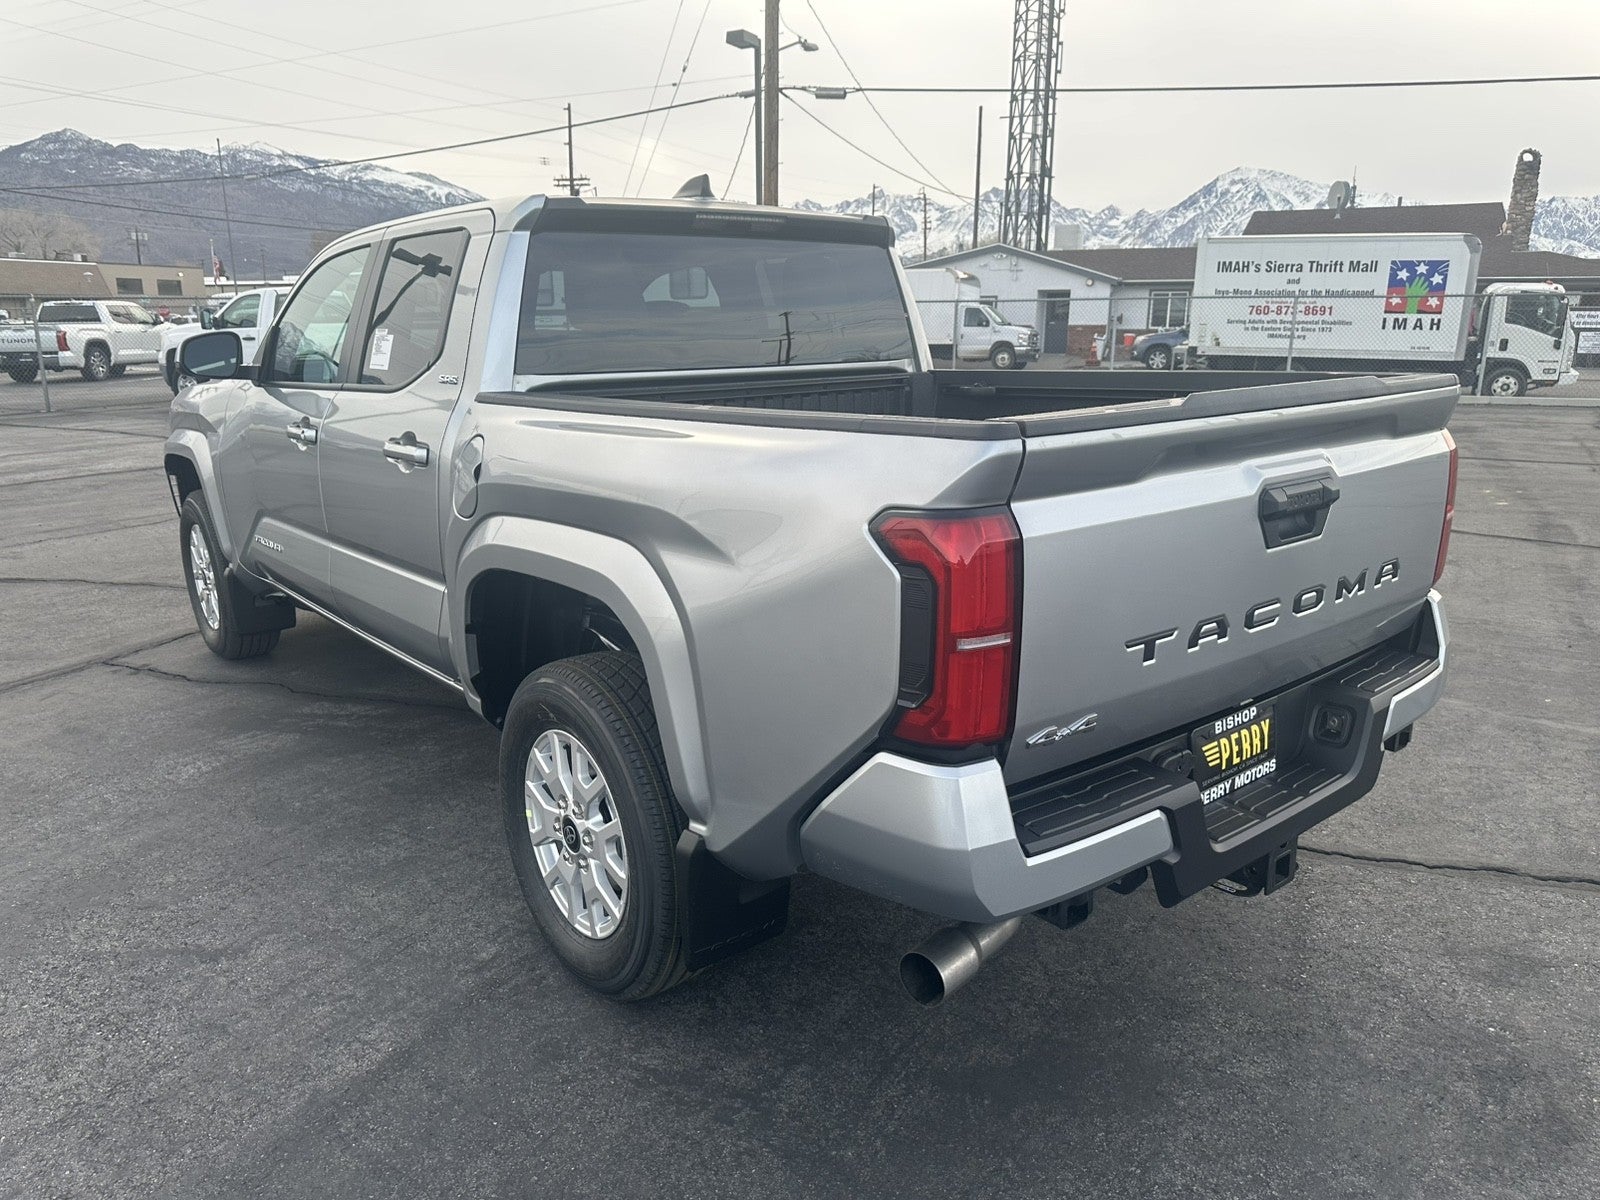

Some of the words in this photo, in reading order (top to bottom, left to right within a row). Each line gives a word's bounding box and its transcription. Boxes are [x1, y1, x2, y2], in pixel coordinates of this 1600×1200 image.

[1216, 260, 1261, 273] IMAH's
[1265, 260, 1303, 273] Sierra
[1308, 260, 1344, 273] Thrift
[1347, 260, 1378, 273] Mall
[1286, 277, 1301, 285] and
[1254, 288, 1296, 297] Association
[1298, 288, 1309, 297] for
[1310, 288, 1323, 297] the
[1381, 317, 1442, 331] IMAH
[1124, 557, 1401, 667] TACOMA
[1214, 706, 1257, 734] BISHOP
[1219, 718, 1270, 770] PERRY
[1234, 758, 1277, 790] MOTORS
